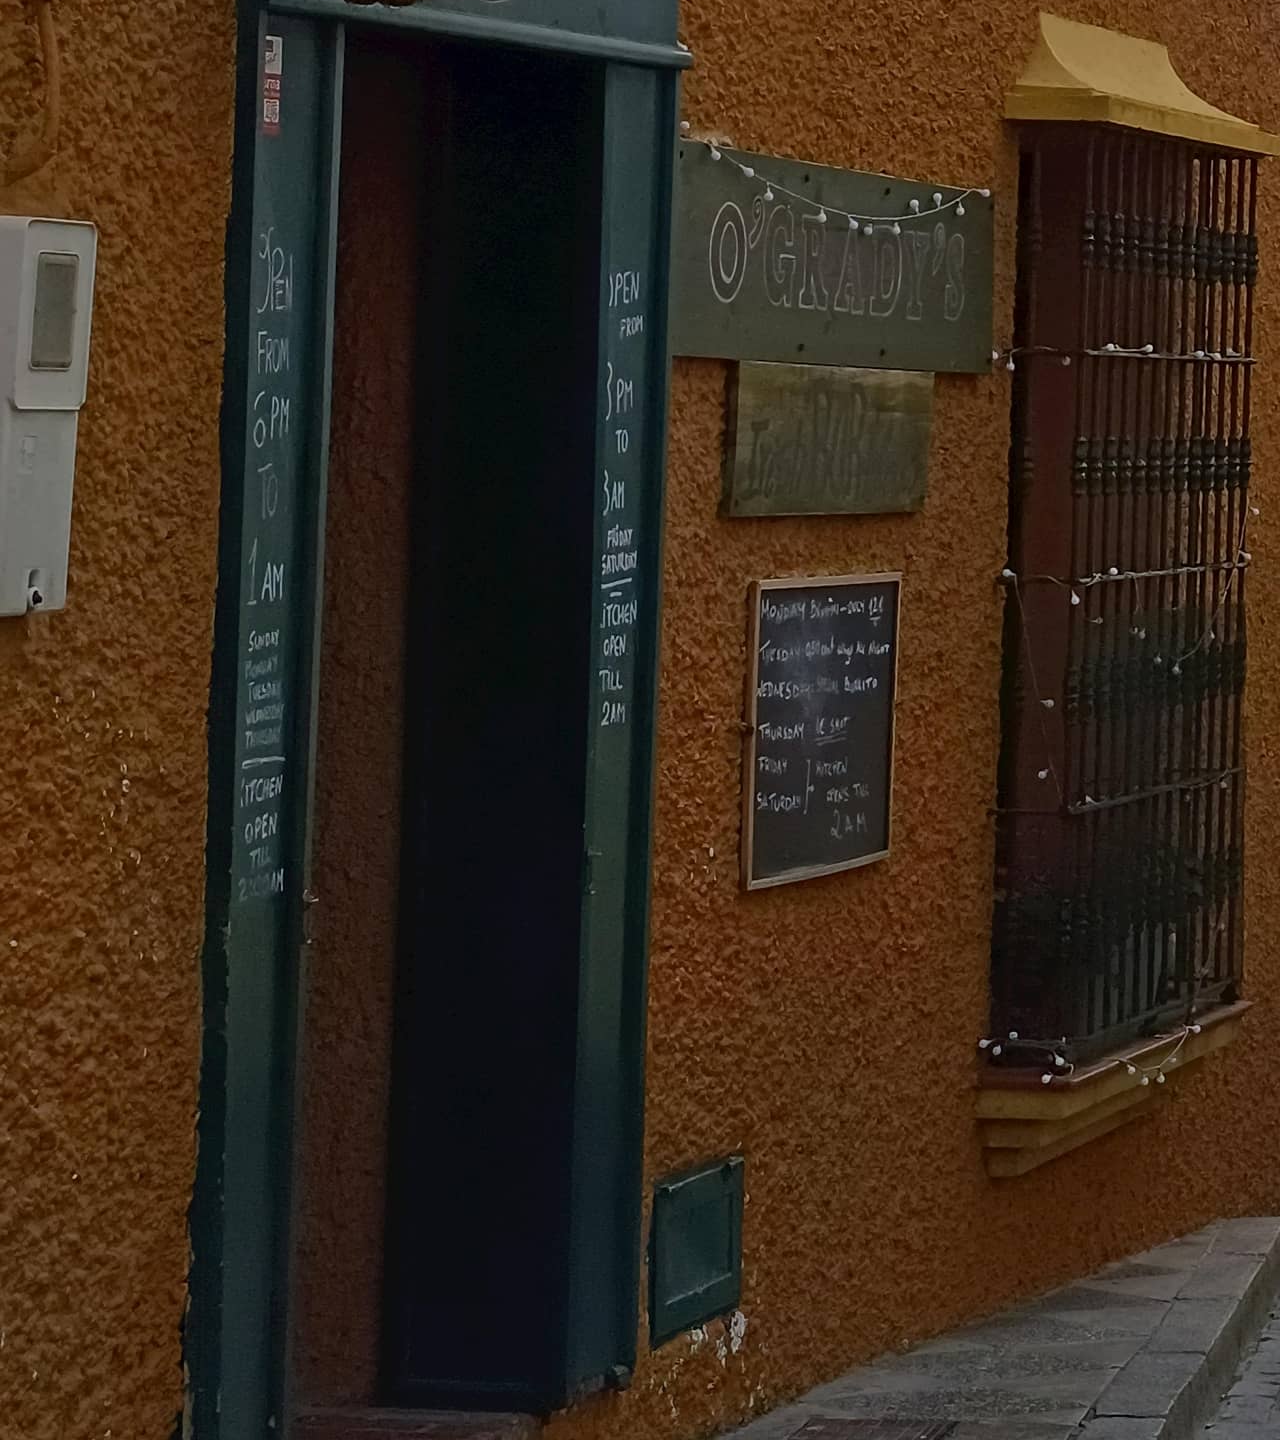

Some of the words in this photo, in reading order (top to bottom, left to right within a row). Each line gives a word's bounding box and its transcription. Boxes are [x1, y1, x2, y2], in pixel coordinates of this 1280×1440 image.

[619, 315, 644, 340] FROM
[257, 330, 290, 373] FROM
[615, 428, 629, 454] TO
[257, 462, 279, 520] TO
[603, 634, 626, 657] OPEN
[757, 721, 805, 741] THURSDAY
[244, 812, 279, 845] OPEN
